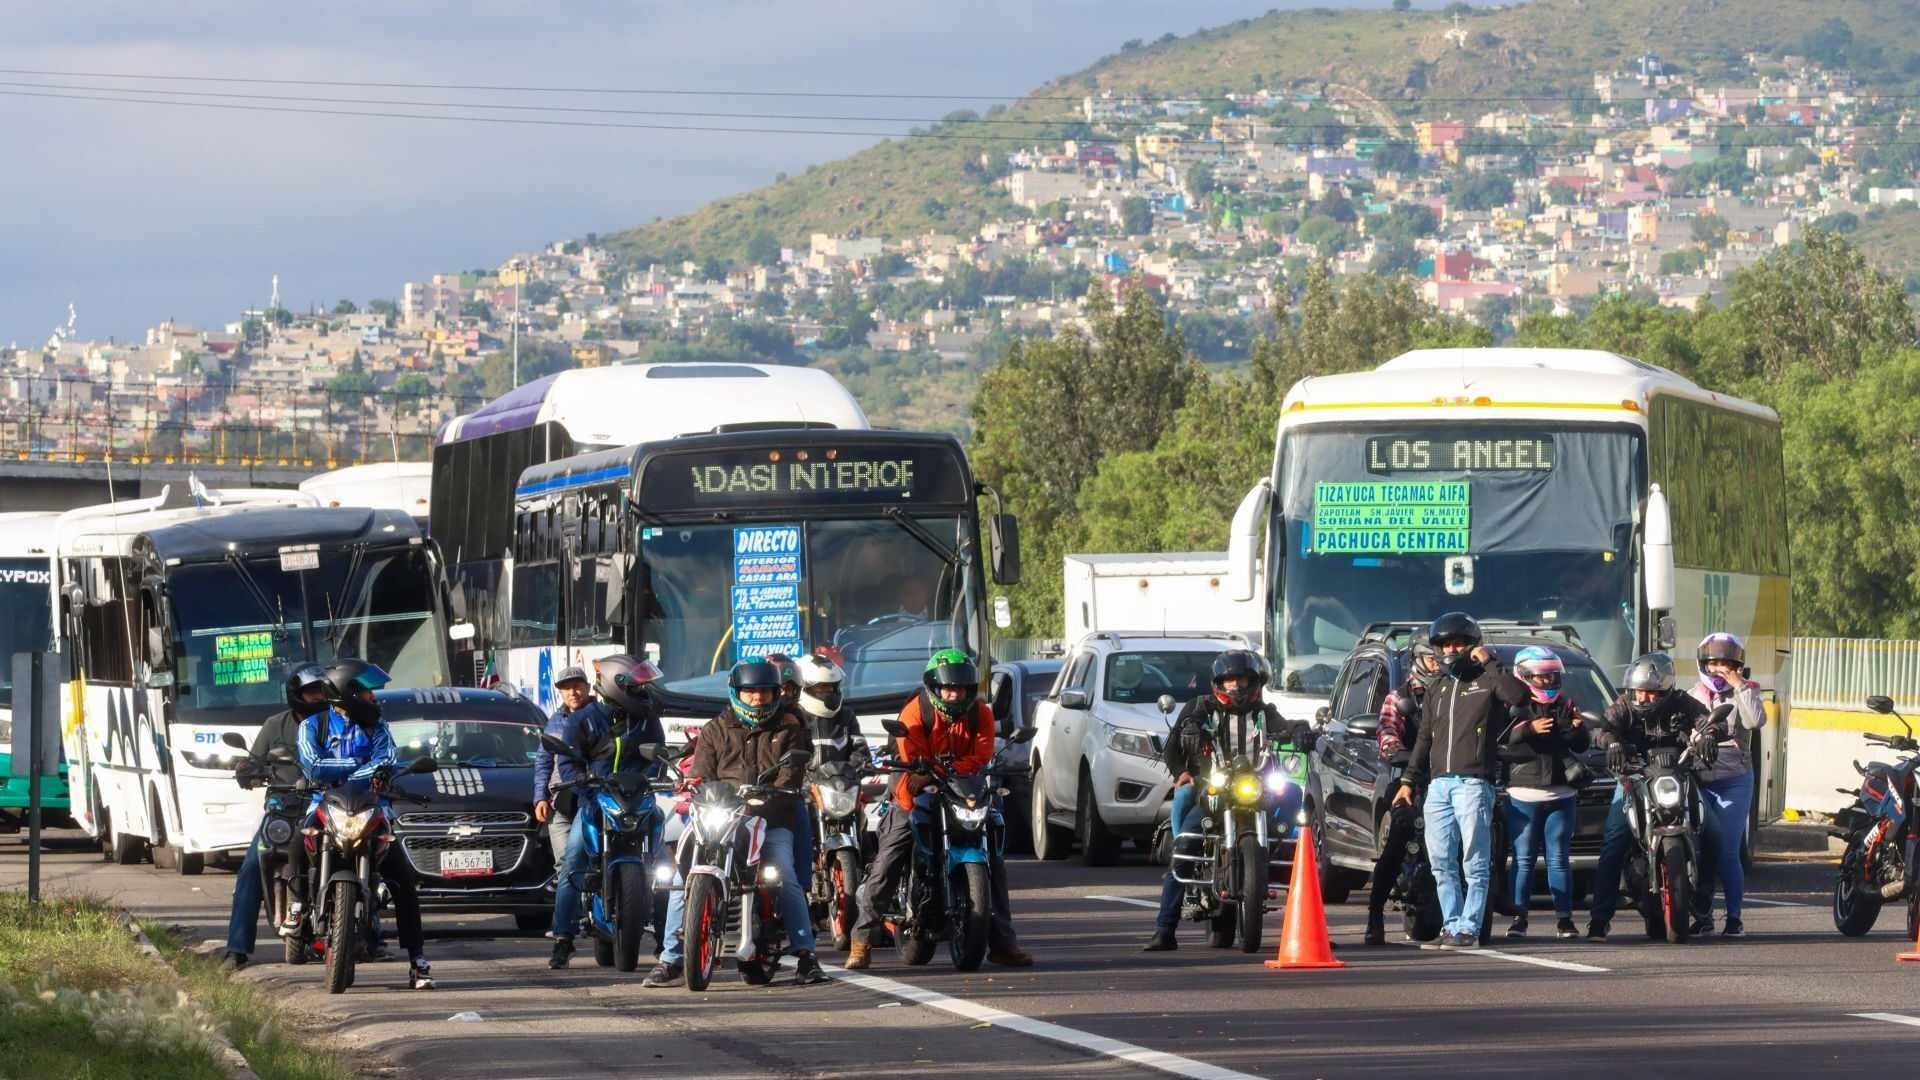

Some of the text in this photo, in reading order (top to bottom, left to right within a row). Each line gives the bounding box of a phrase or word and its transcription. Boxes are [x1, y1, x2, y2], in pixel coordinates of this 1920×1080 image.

[1371, 440, 1552, 469] LOS ANGEL
[1319, 485, 1465, 502] TIZAYUCA TECAMAC AIFA
[1319, 517, 1465, 525] SORIANA DEL VALLE
[736, 529, 798, 553] DIRECTO
[1318, 532, 1465, 549] PACHUCA CENTRAL
[738, 556, 797, 566] INTERIOR
[0, 569, 50, 584] YPOX
[739, 573, 773, 583] CASAS
[738, 622, 794, 631] JARDINES
[737, 629, 796, 640] DE TIZAYUCA
[741, 643, 800, 657] TIZAYUCA
